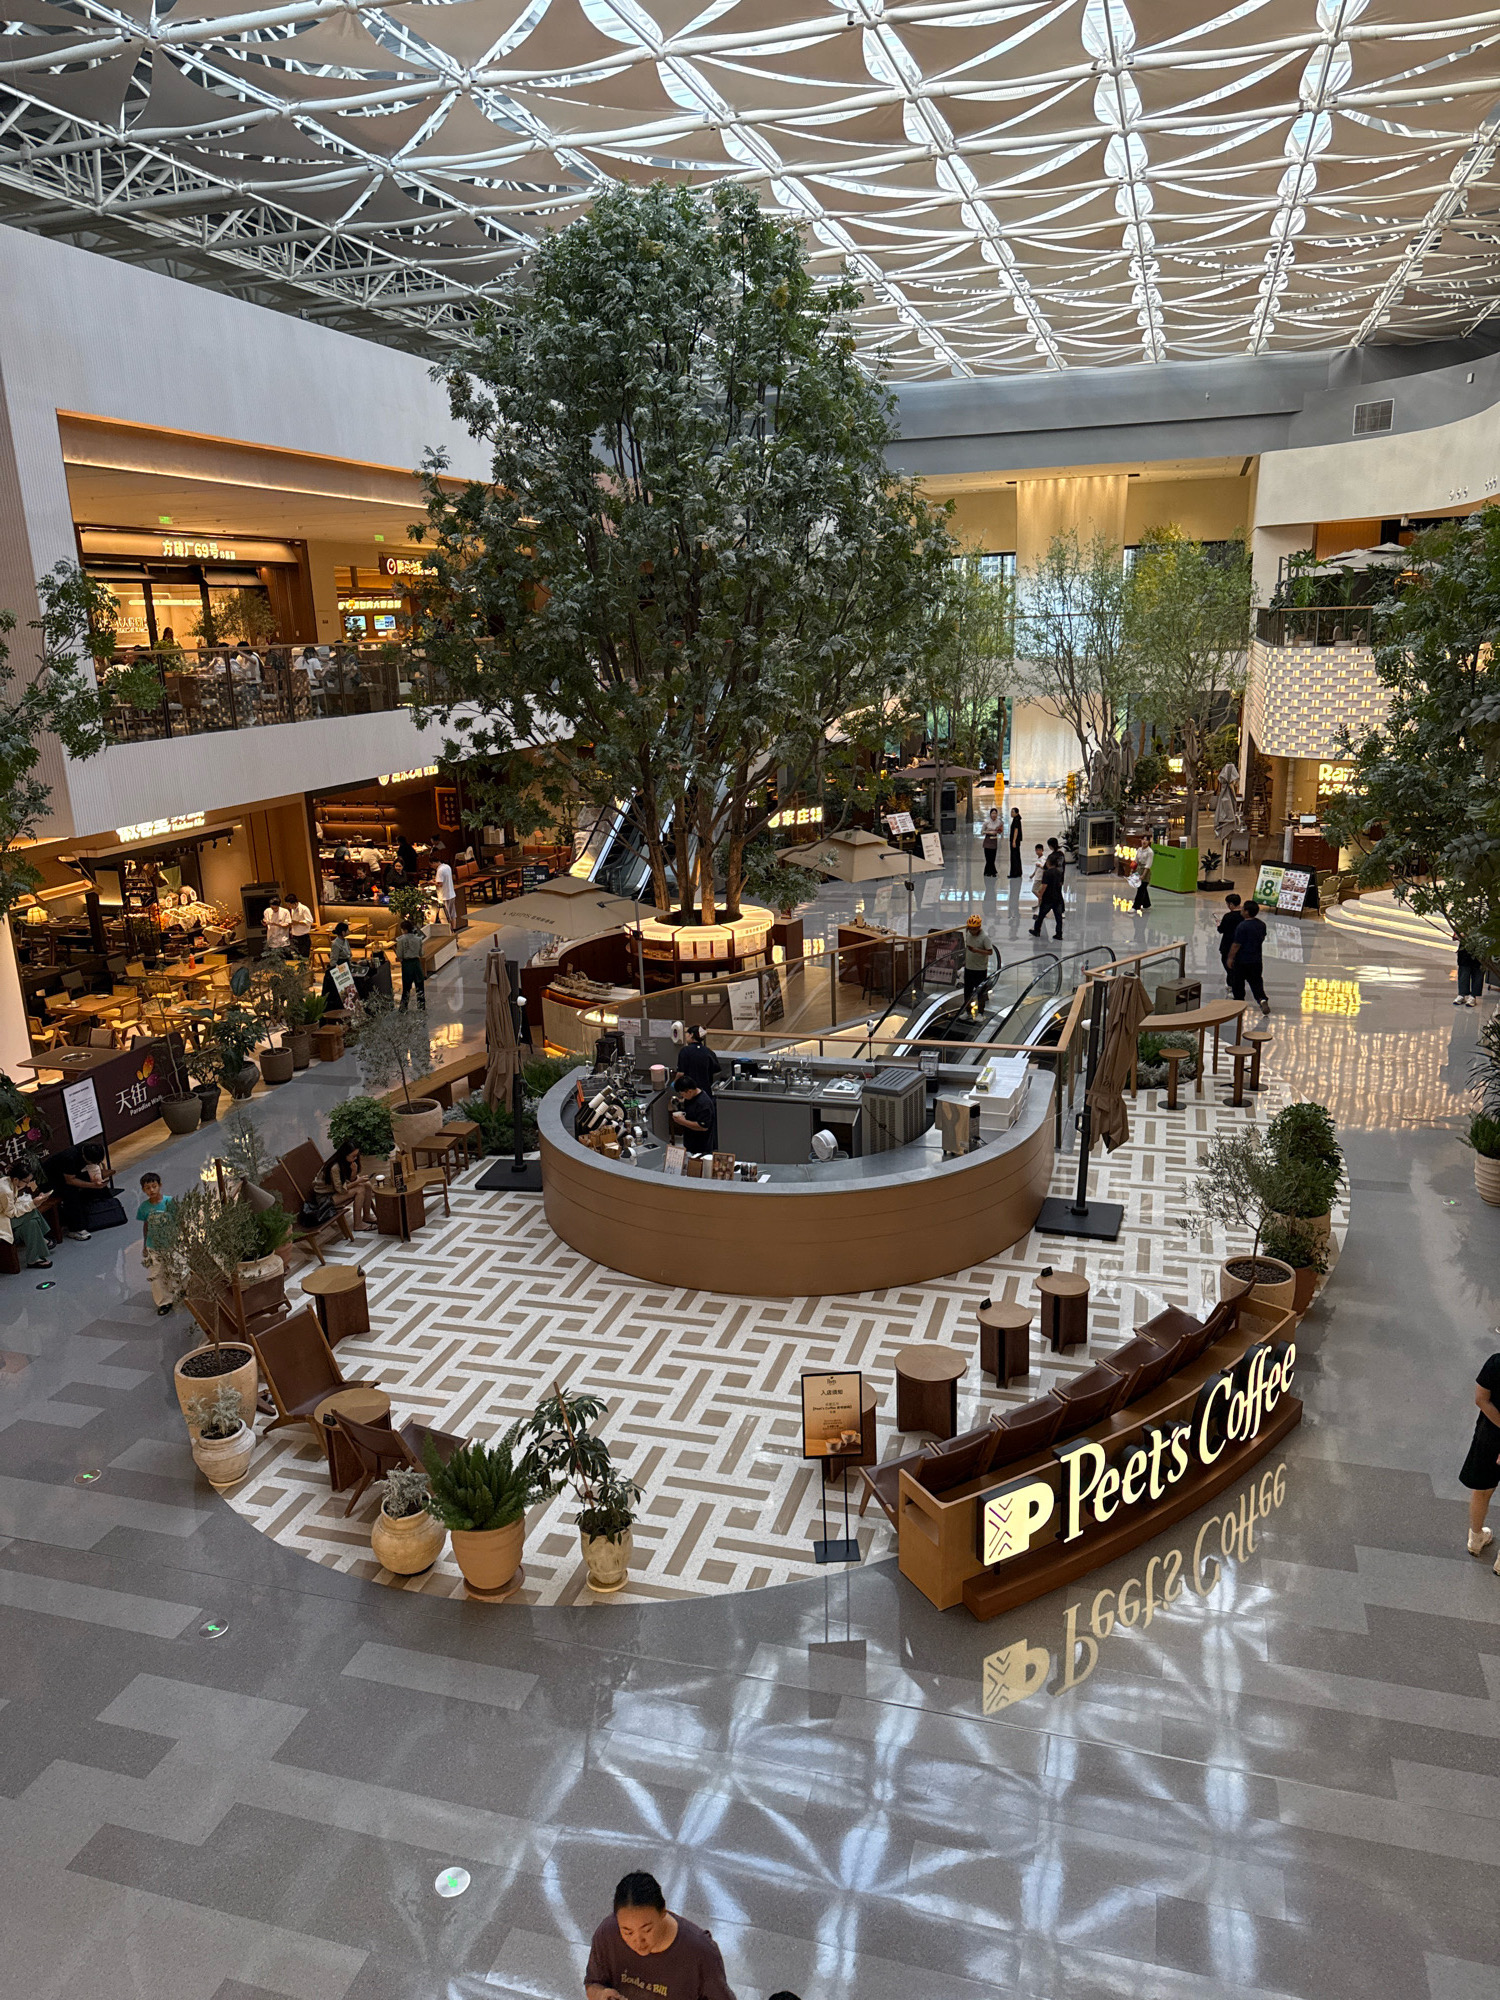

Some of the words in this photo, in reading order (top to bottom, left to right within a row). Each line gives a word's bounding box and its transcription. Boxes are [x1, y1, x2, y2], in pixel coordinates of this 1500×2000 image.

[1262, 879, 1275, 897] 8
[115, 1081, 147, 1115] 天街
[129, 1101, 152, 1117] Paradise
[1060, 1424, 1192, 1544] Peet's
[1199, 1343, 1296, 1464] Coffee
